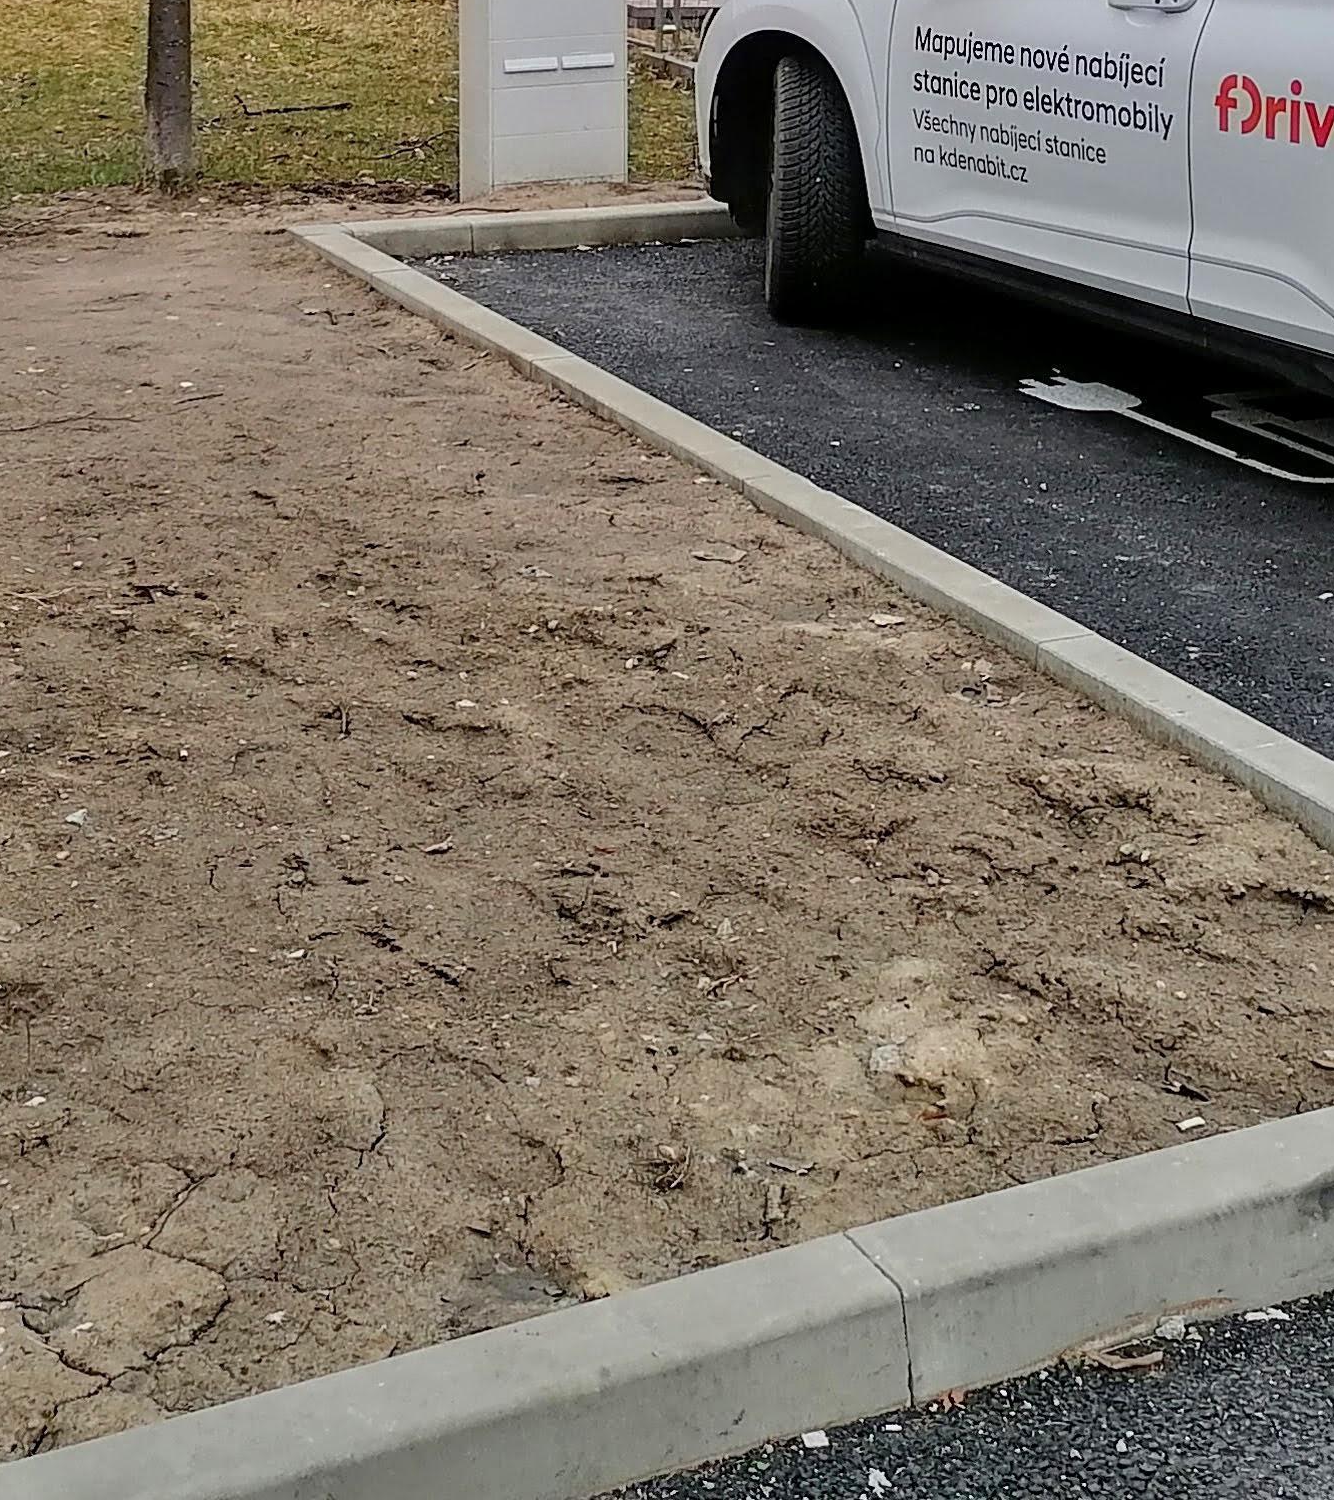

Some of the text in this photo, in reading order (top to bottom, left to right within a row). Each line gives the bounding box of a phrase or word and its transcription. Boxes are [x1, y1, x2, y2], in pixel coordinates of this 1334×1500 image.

[914, 26, 1166, 89] Mapujeme nové nabíjecí
[913, 71, 1174, 141] stanice pro elektromobily
[913, 108, 1107, 165] Všechny nabíjecí stanice
[914, 146, 1029, 184] na kdenabit.cz
